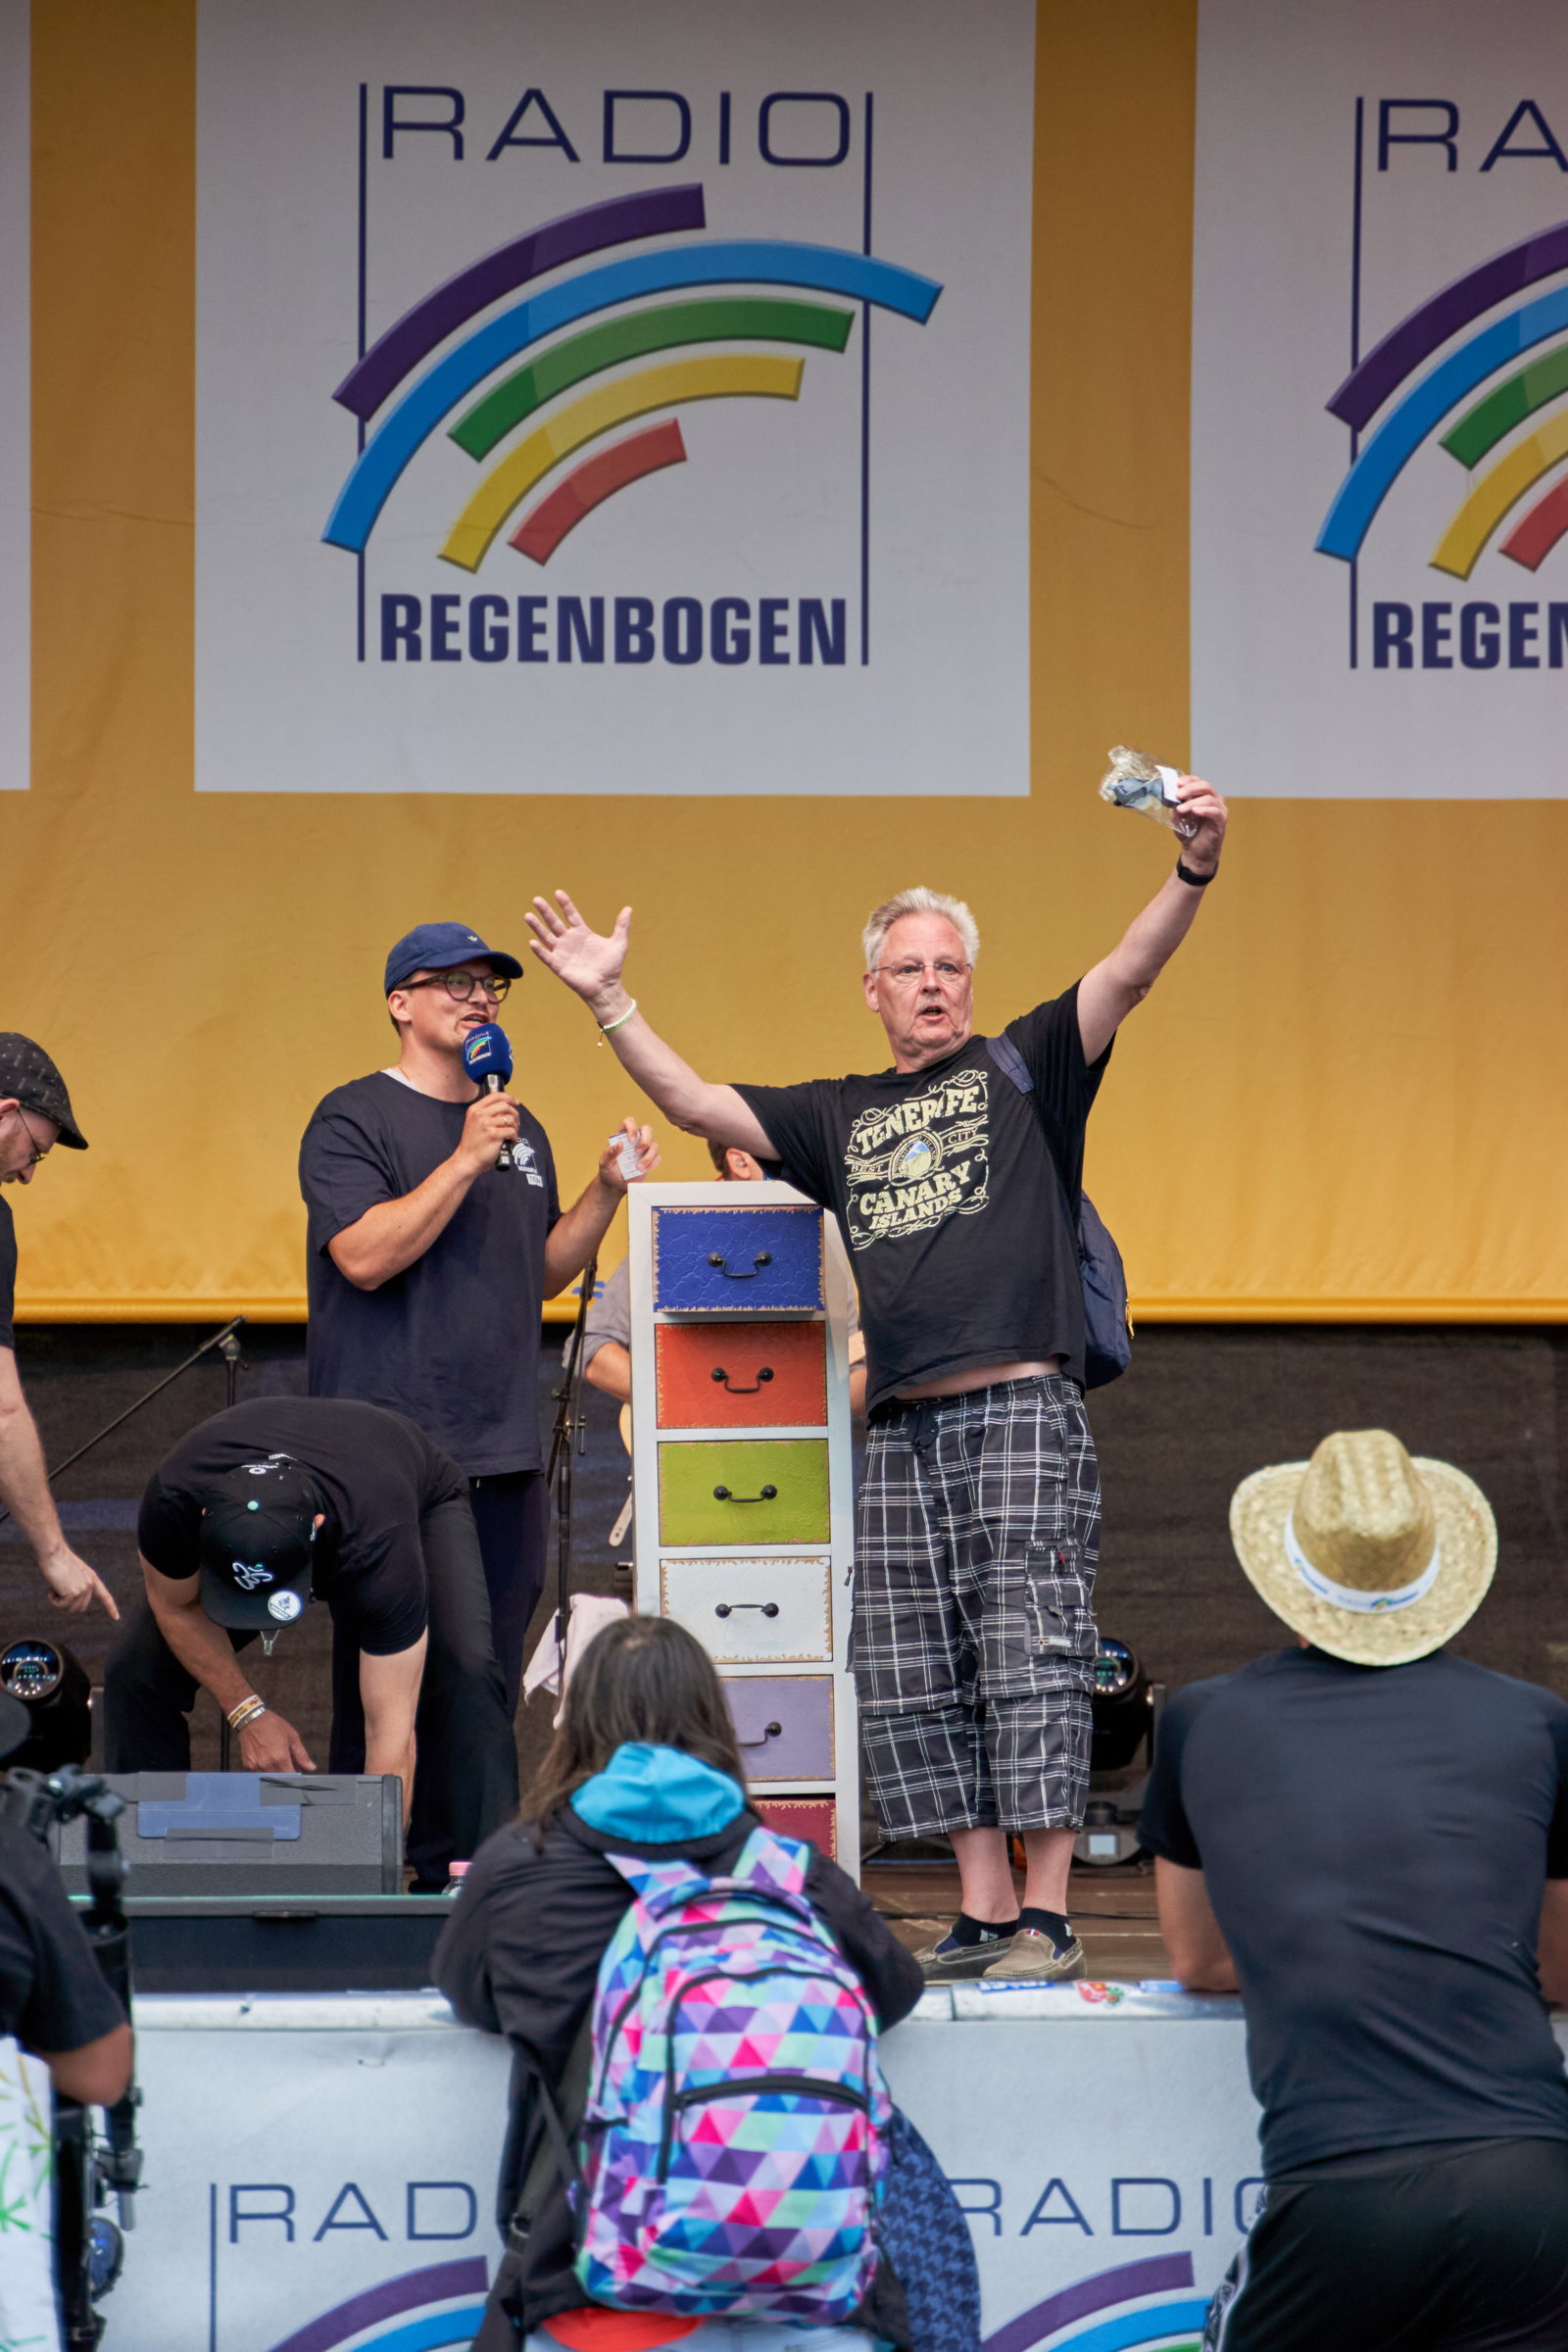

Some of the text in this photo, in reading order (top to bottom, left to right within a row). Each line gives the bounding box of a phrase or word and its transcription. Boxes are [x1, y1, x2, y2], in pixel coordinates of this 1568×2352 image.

[383, 85, 851, 167] RADIO
[380, 593, 847, 665] REGENBOGEN
[857, 1086, 979, 1154] TENERIFE
[948, 1127, 978, 1144] CITY
[859, 1160, 970, 1215] CANARY
[868, 1188, 962, 1230] ISLANDS
